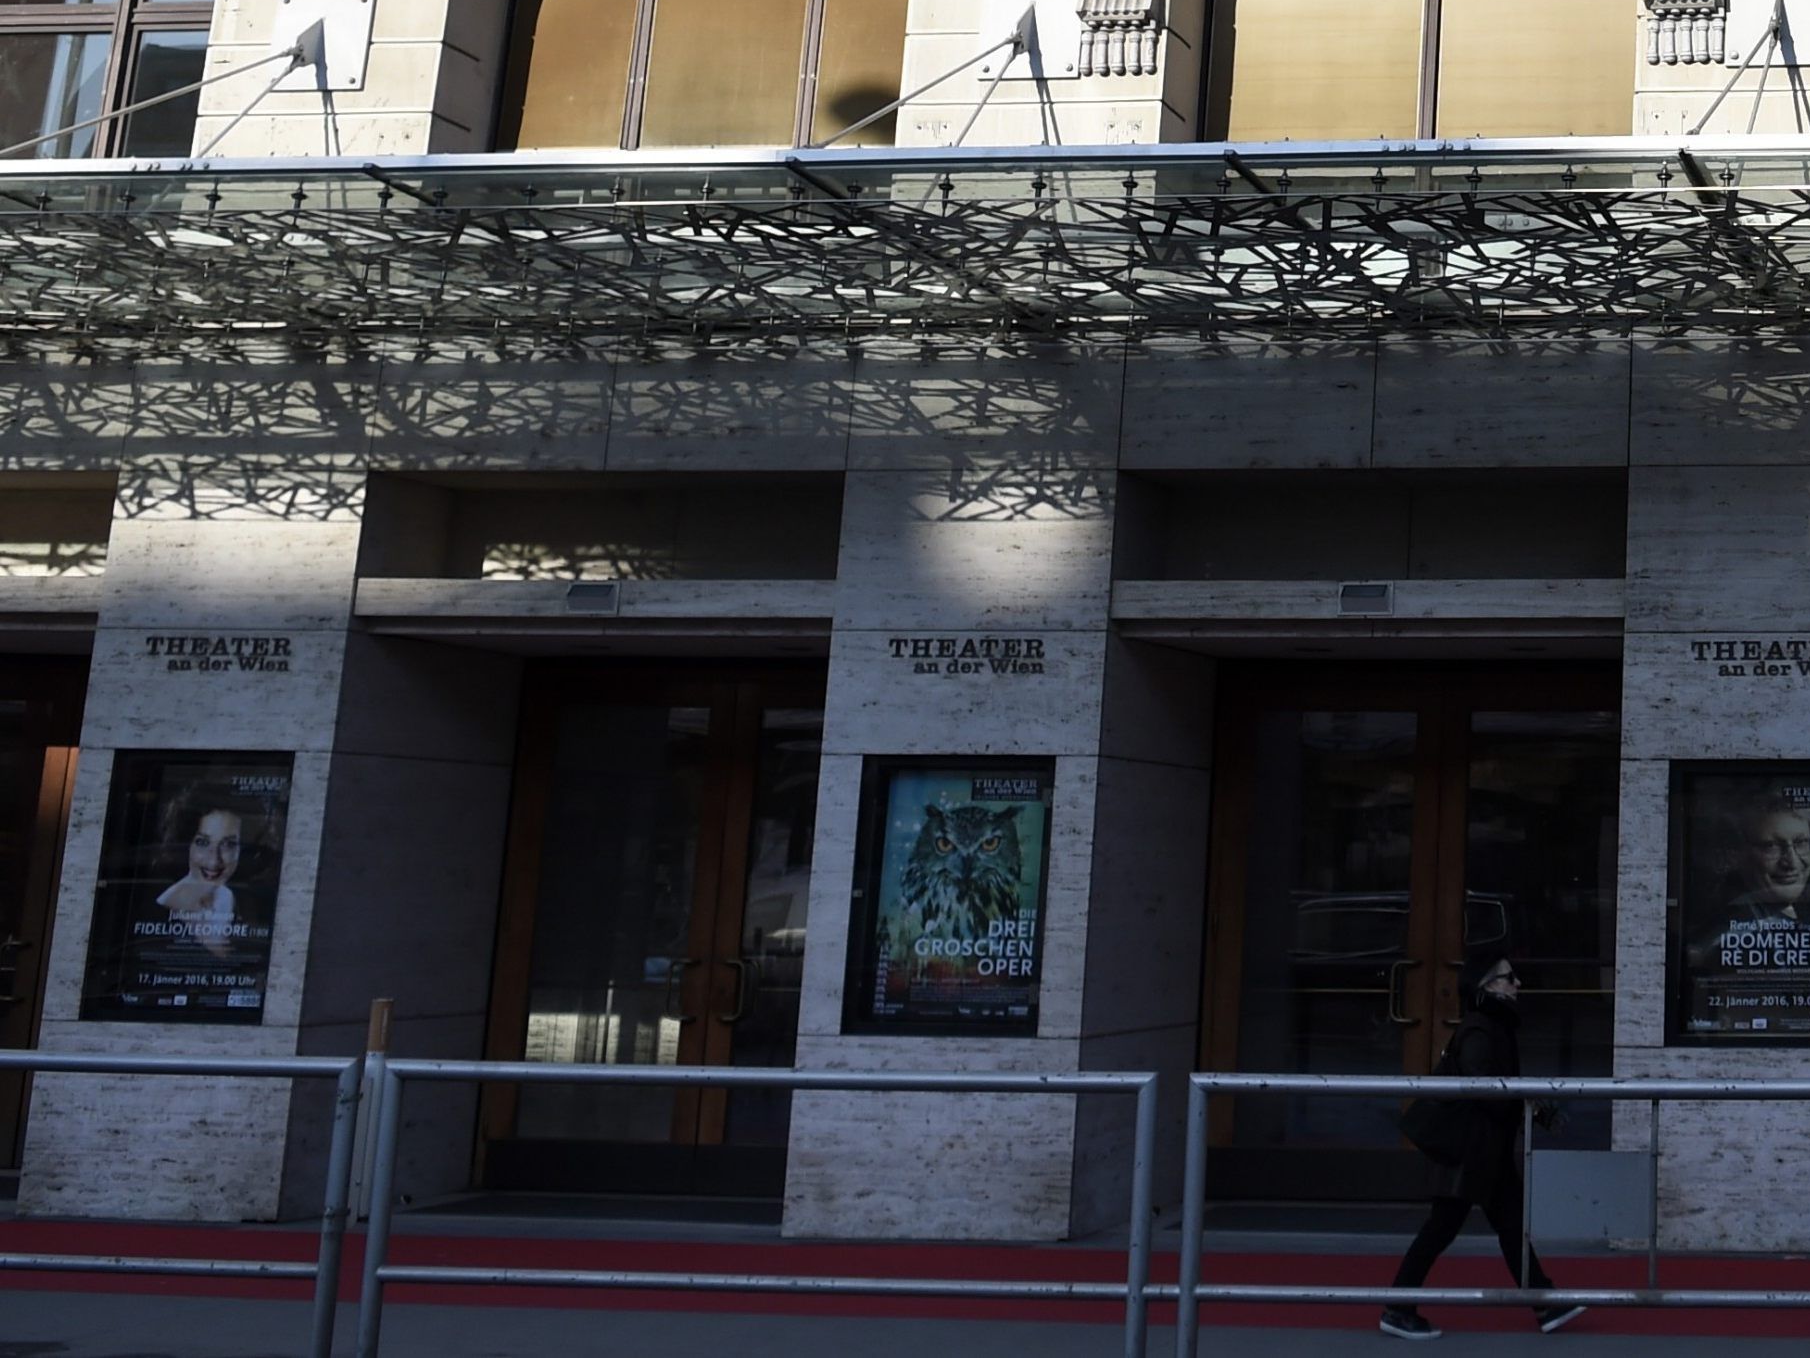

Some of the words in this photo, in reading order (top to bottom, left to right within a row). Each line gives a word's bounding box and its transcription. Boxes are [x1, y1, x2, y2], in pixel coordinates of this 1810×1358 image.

[146, 636, 291, 656] THEATER
[889, 638, 1045, 658] THEATER
[168, 659, 192, 671] an
[198, 656, 232, 671] der
[238, 656, 290, 671] Wien
[913, 662, 939, 674] an
[946, 659, 984, 674] der
[989, 658, 1045, 674] Wien
[1718, 664, 1746, 676] an
[1753, 661, 1792, 676] der
[974, 778, 1039, 788] THEATER
[134, 921, 249, 939] FIDELIO/LEONORE
[988, 919, 1036, 938] DREI
[1729, 918, 1757, 931] René
[1759, 918, 1796, 932] Jacobs
[914, 937, 1034, 957] GROSCHEN
[1748, 949, 1769, 966] DI
[977, 958, 1034, 977] OPER
[1707, 995, 1724, 1007] 22.
[1726, 995, 1759, 1009] Jänner
[1762, 995, 1790, 1008] 2016,
